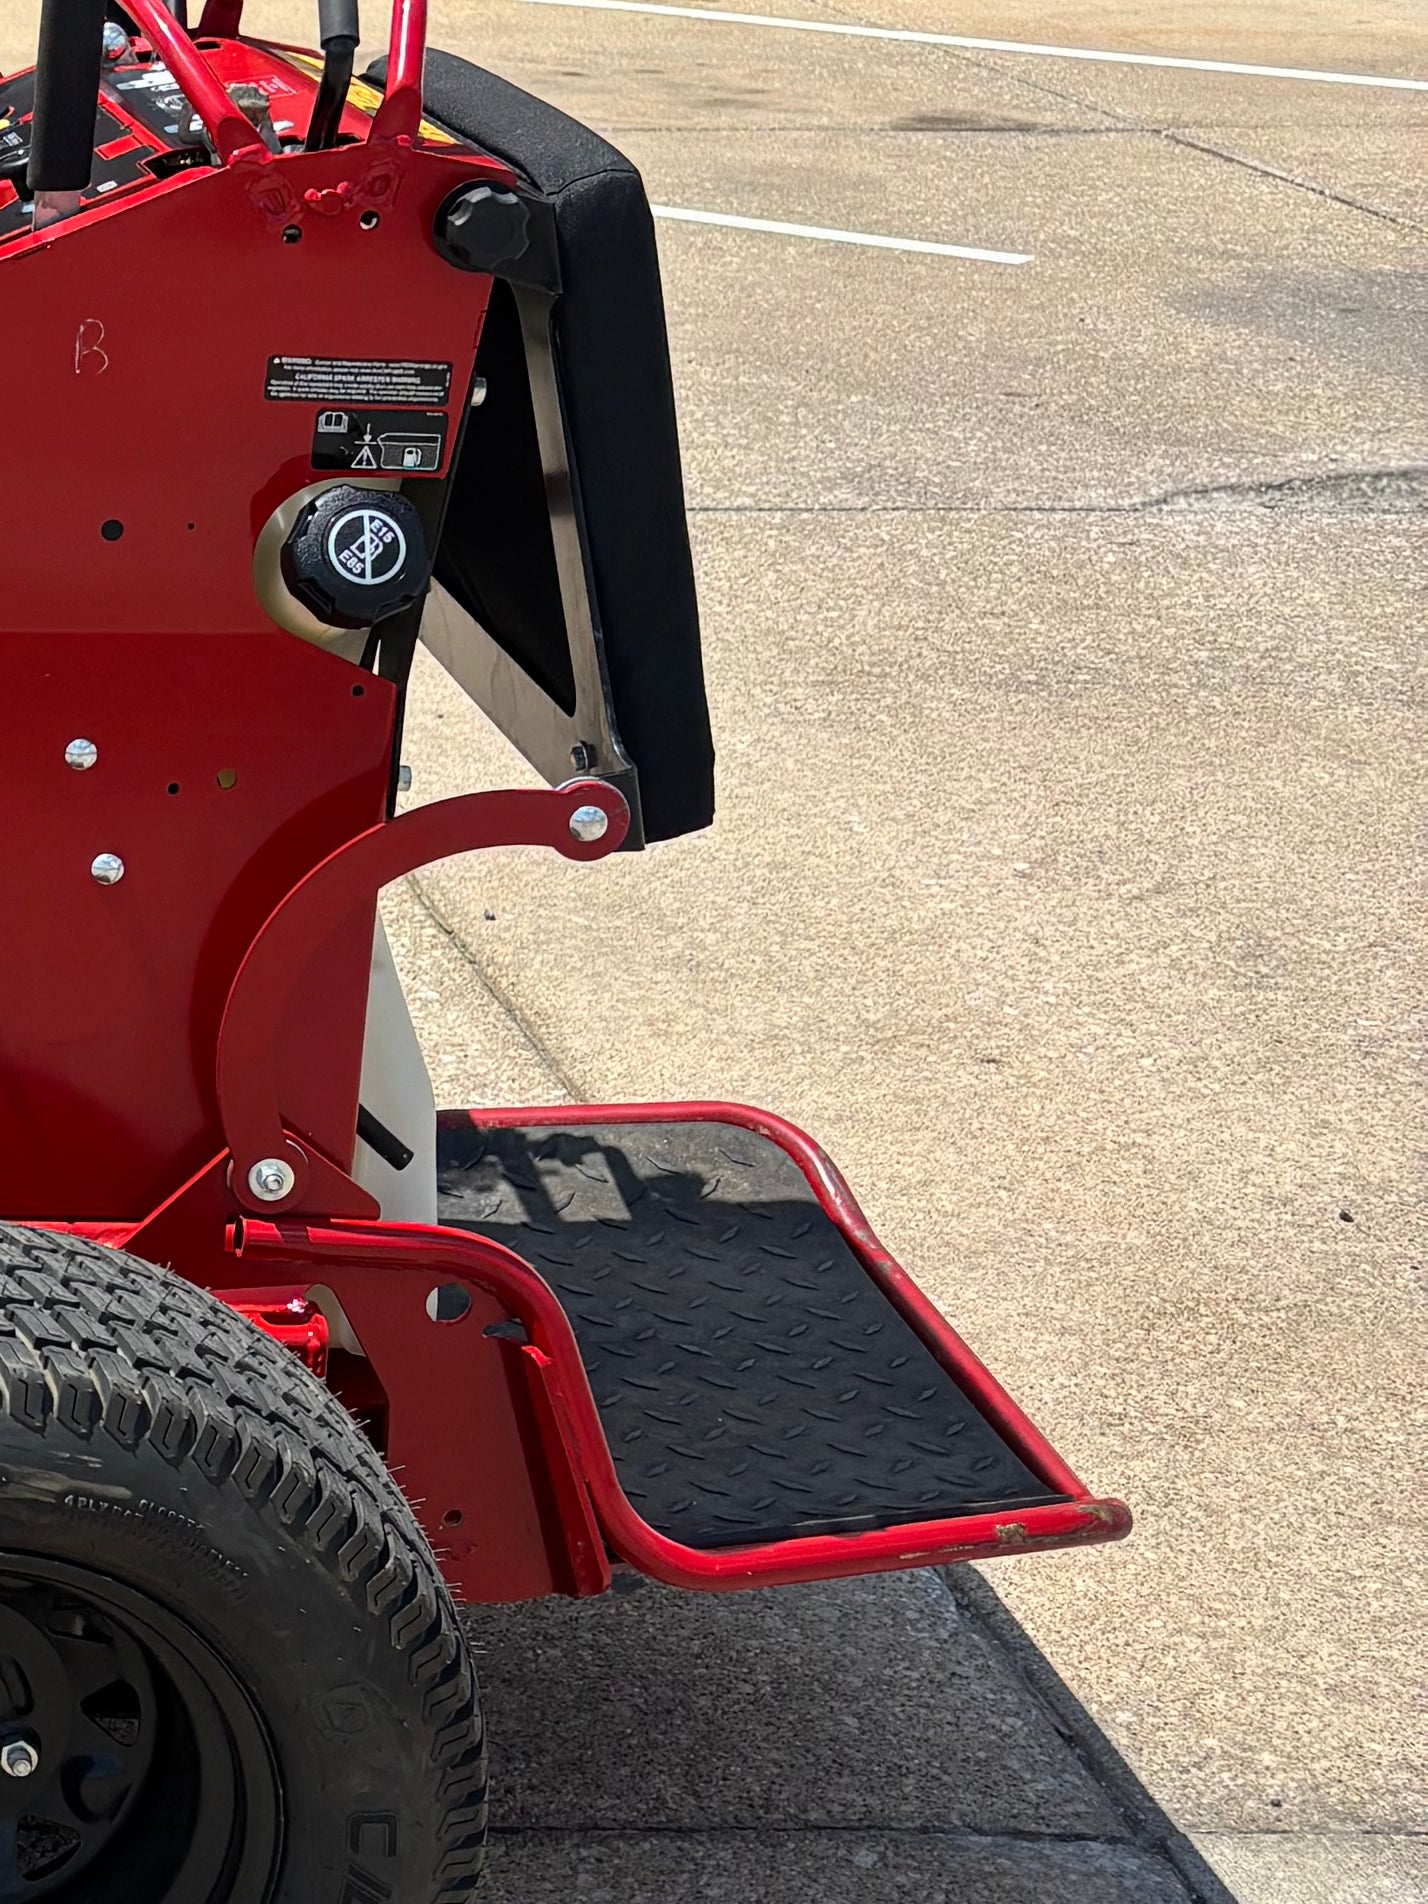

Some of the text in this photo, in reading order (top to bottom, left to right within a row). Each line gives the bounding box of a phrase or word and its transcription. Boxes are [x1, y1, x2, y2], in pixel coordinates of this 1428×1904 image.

[74, 317, 110, 376] B
[369, 518, 395, 543] E15
[338, 549, 365, 575] E85
